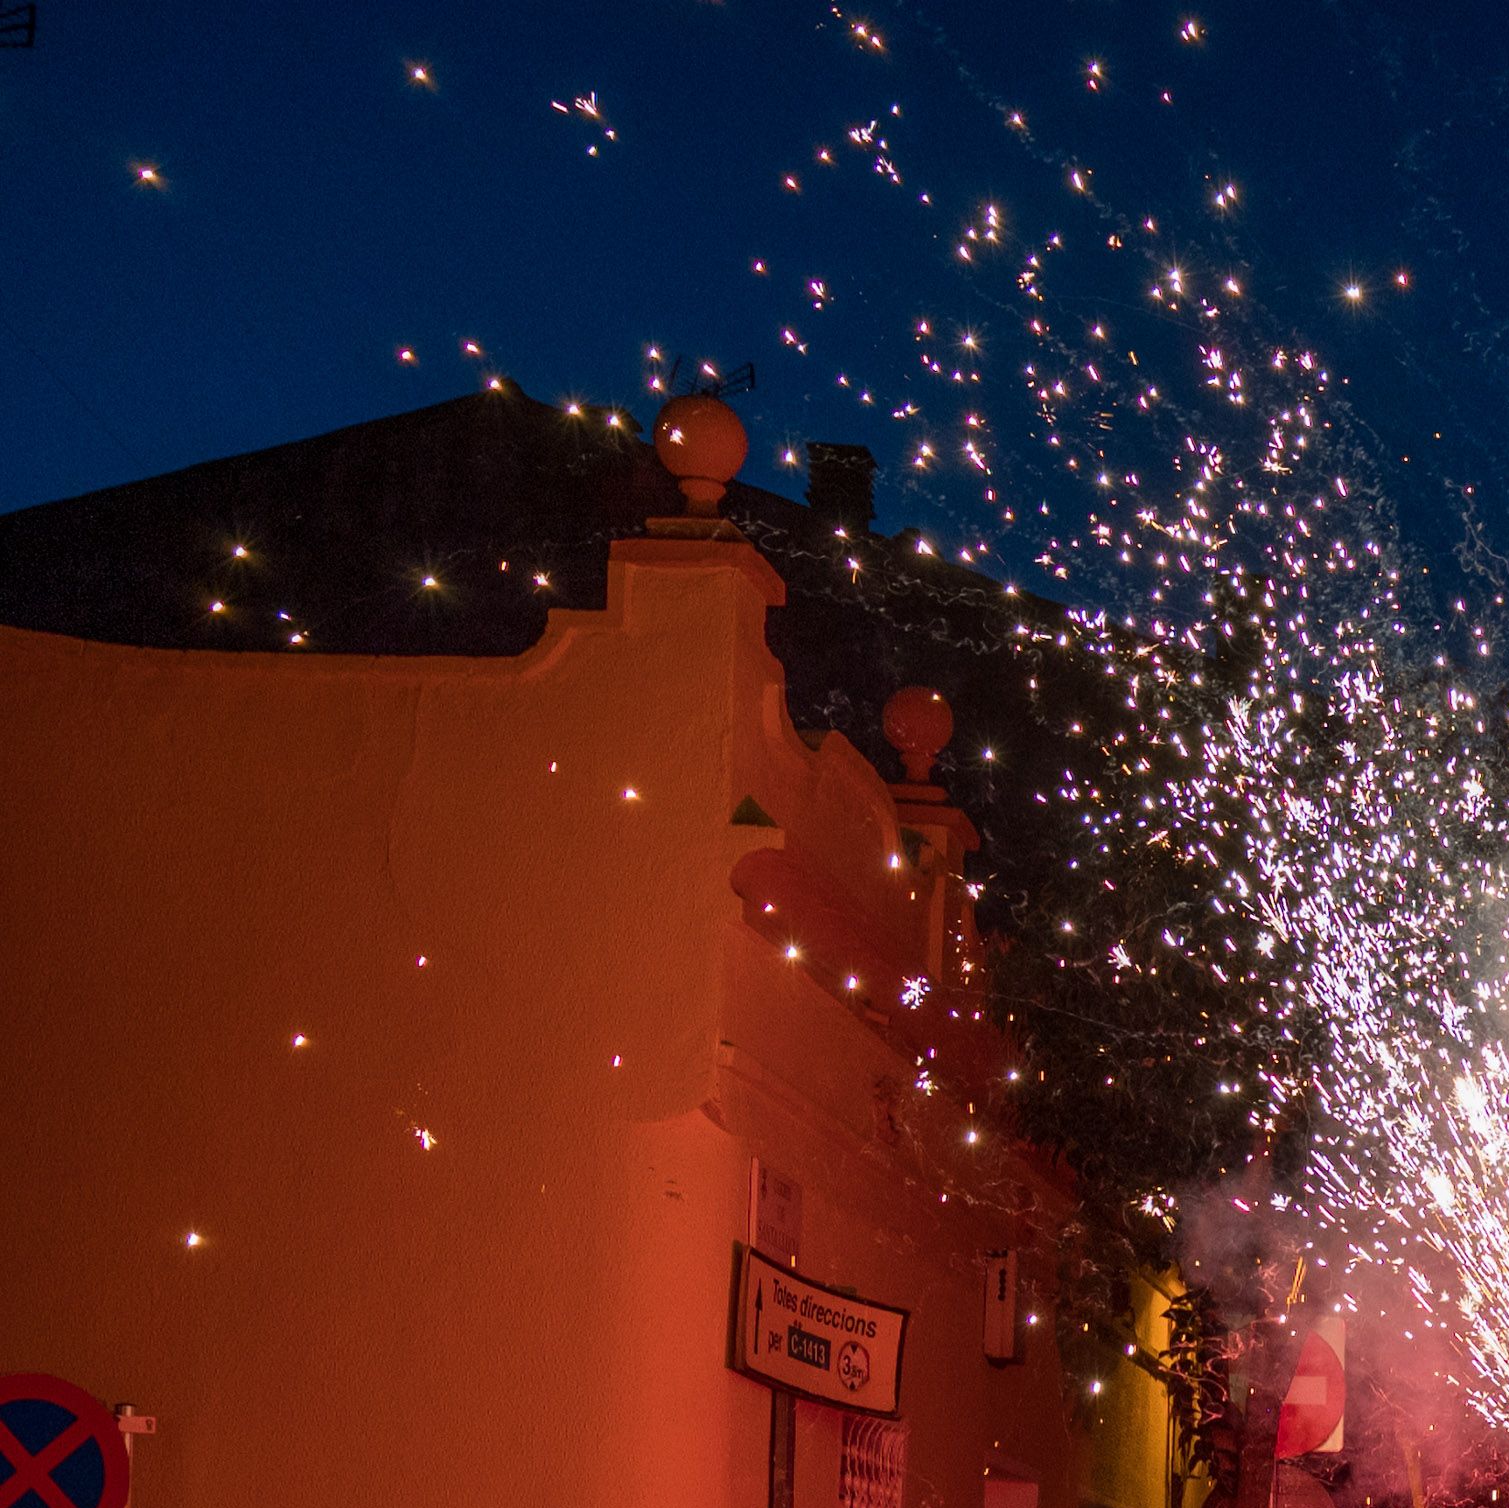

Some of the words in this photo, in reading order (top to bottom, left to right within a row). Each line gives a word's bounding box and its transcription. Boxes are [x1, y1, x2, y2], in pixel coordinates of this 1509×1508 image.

[772, 1278, 798, 1314] Totes
[800, 1295, 877, 1338] direccions
[768, 1331, 783, 1354] per
[791, 1334, 825, 1364] C-1413
